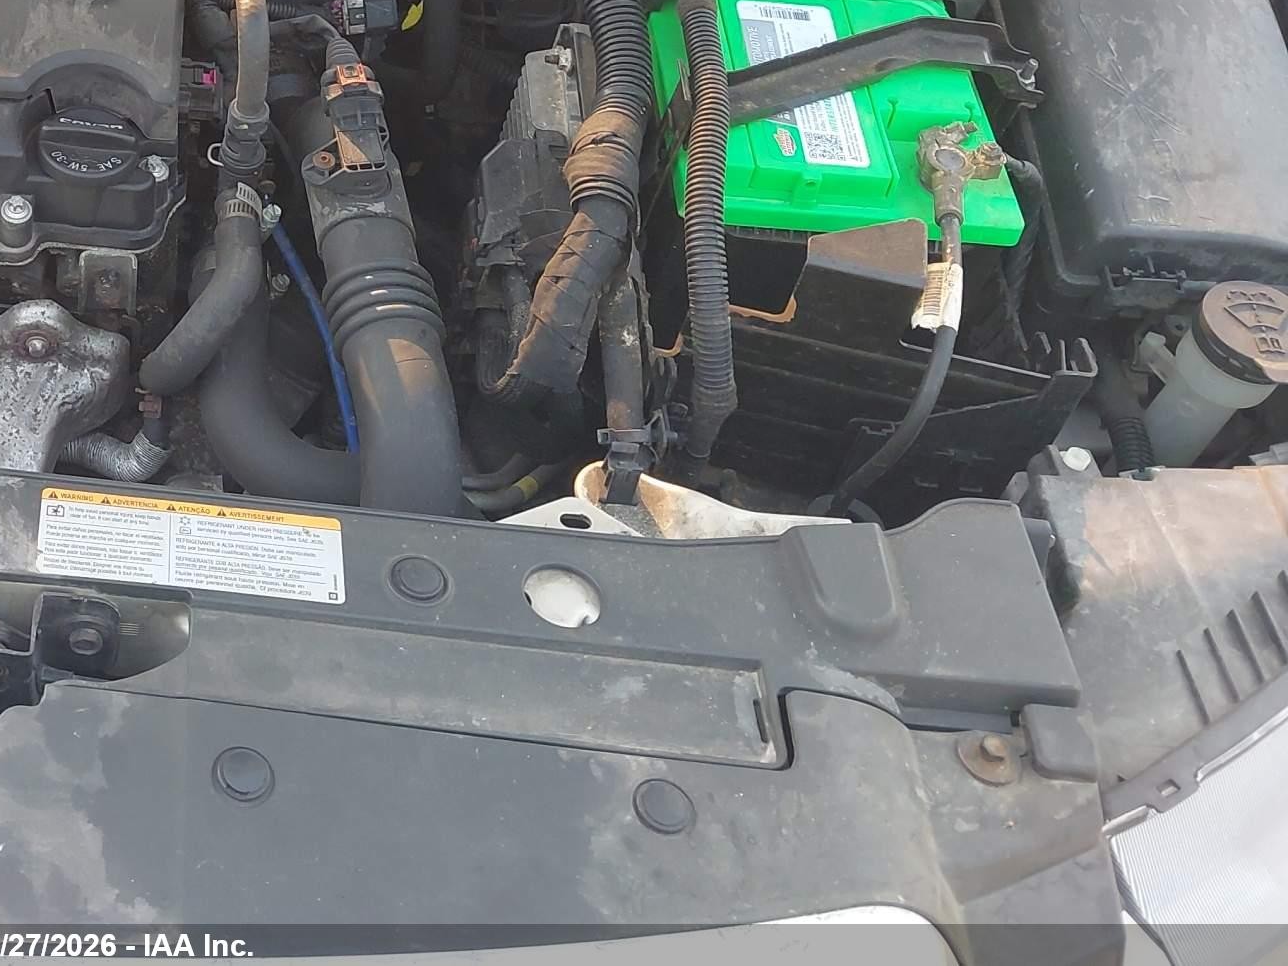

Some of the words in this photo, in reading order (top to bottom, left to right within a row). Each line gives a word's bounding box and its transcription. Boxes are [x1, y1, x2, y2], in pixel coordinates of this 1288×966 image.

[50, 150, 89, 172] 5W-30
[96, 156, 123, 172] SAE
[60, 493, 94, 502] WARNING
[112, 498, 157, 508] ADVERTENCIA
[178, 505, 210, 513] ATENÇÃO
[229, 510, 284, 520] AVERTISSEMENT
